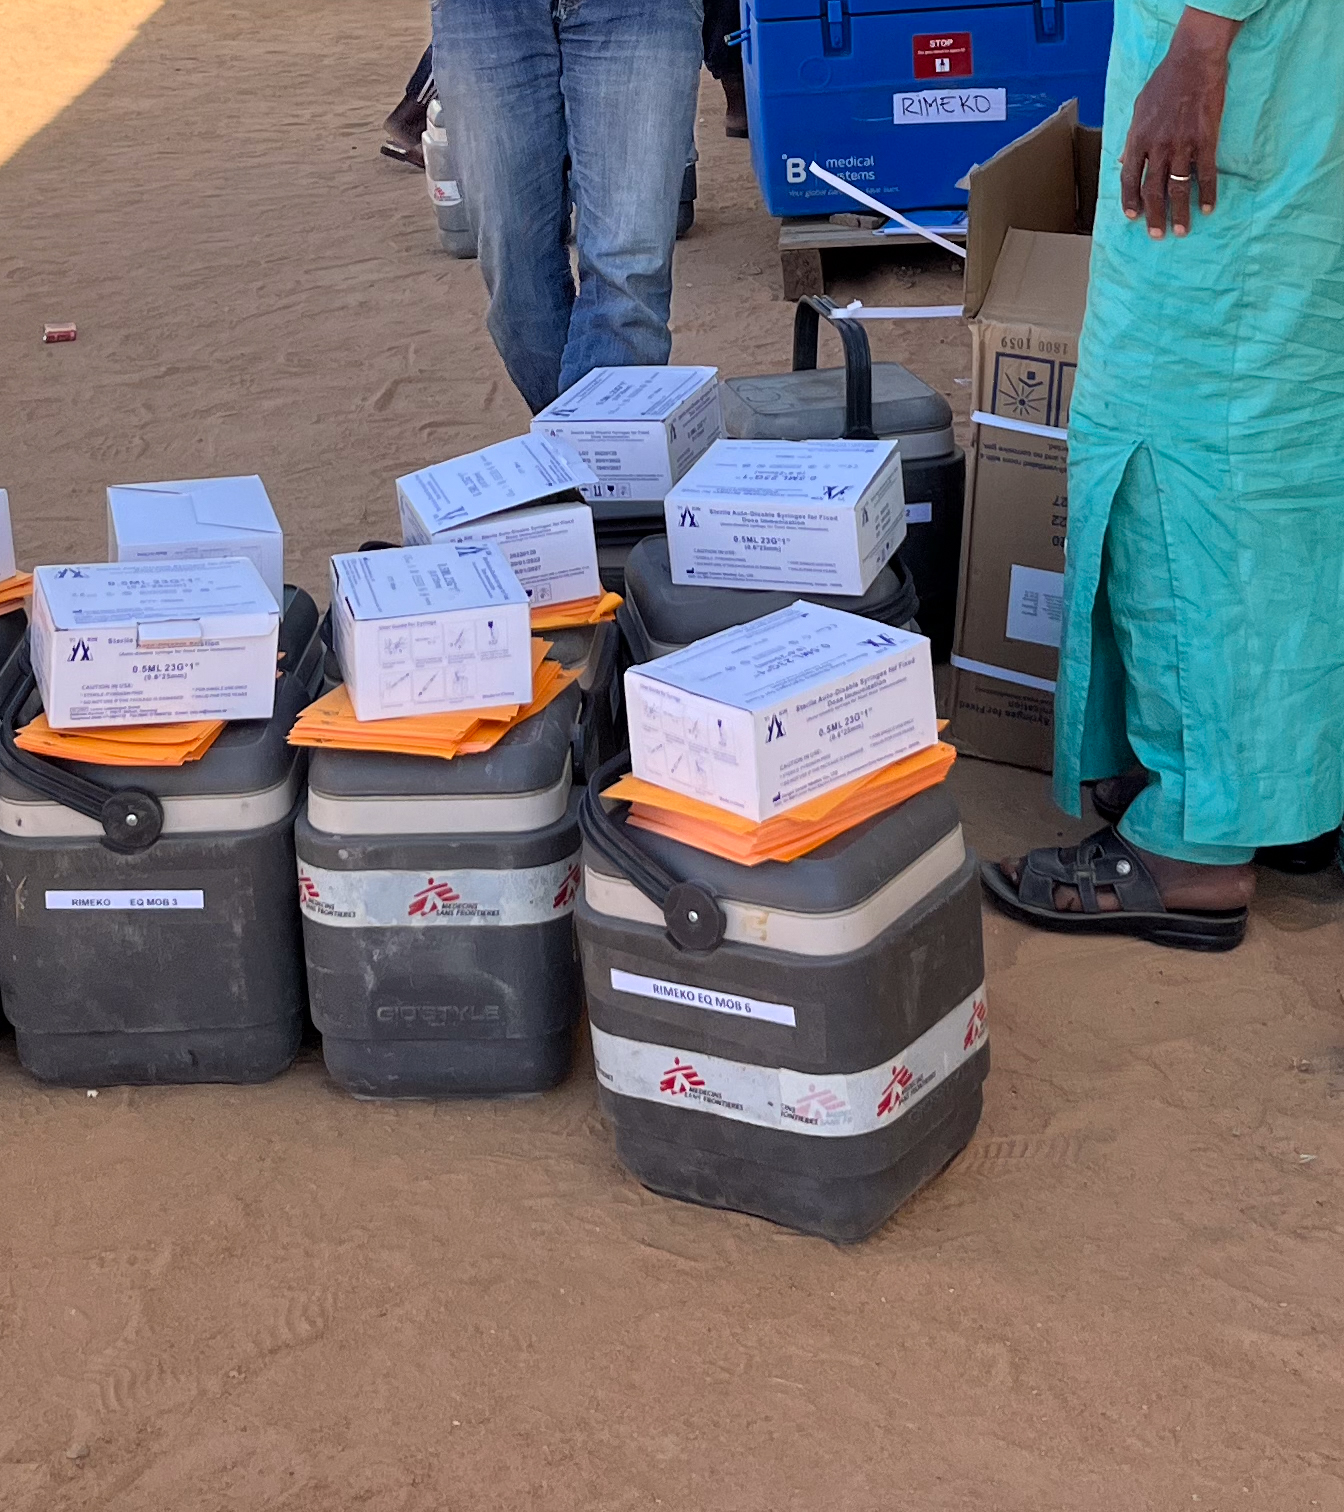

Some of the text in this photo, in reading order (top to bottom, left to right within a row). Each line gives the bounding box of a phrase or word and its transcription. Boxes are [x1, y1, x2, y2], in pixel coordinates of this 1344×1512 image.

[929, 38, 954, 48] STOP
[901, 94, 991, 117] RIMEKO
[825, 155, 875, 168] medical
[836, 170, 876, 181] stems
[1001, 336, 1032, 349] 1059
[71, 898, 178, 907] RIMEKO EQ MOB 3
[441, 902, 478, 910] MEDECINS
[435, 909, 500, 917] SANS FRONTIERES
[652, 983, 752, 1013] RIMEKO EQ MOB 6
[688, 1086, 723, 1100] MEDECINS
[703, 1095, 744, 1111] FRONTIERES
